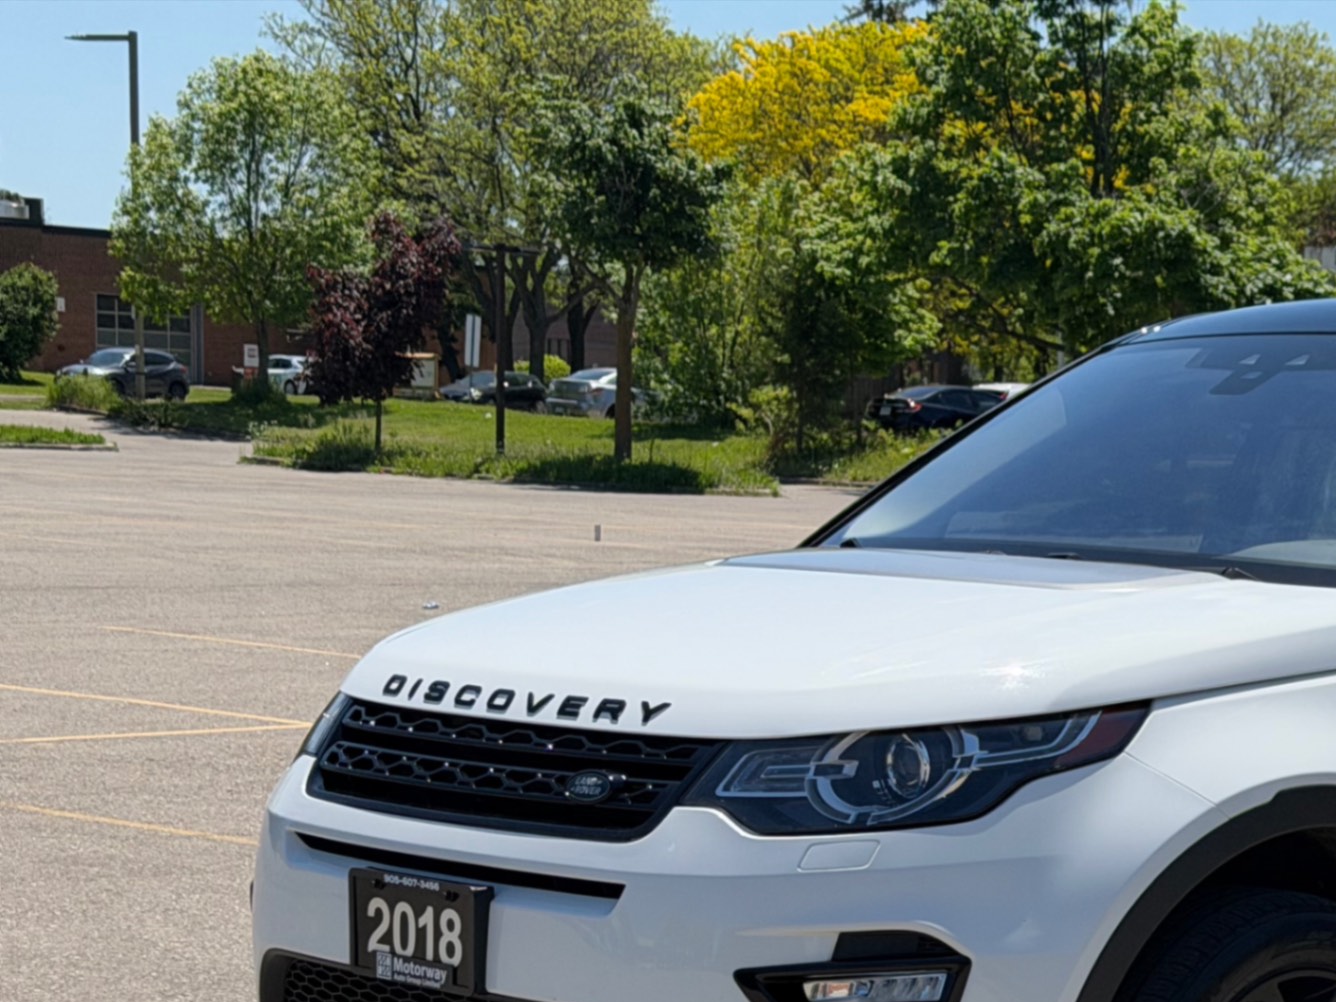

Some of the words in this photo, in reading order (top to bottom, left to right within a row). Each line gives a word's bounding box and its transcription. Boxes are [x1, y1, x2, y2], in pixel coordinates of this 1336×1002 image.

[383, 674, 670, 723] DISCOVERY
[366, 896, 463, 967] 2018
[393, 956, 448, 985] Motorway
